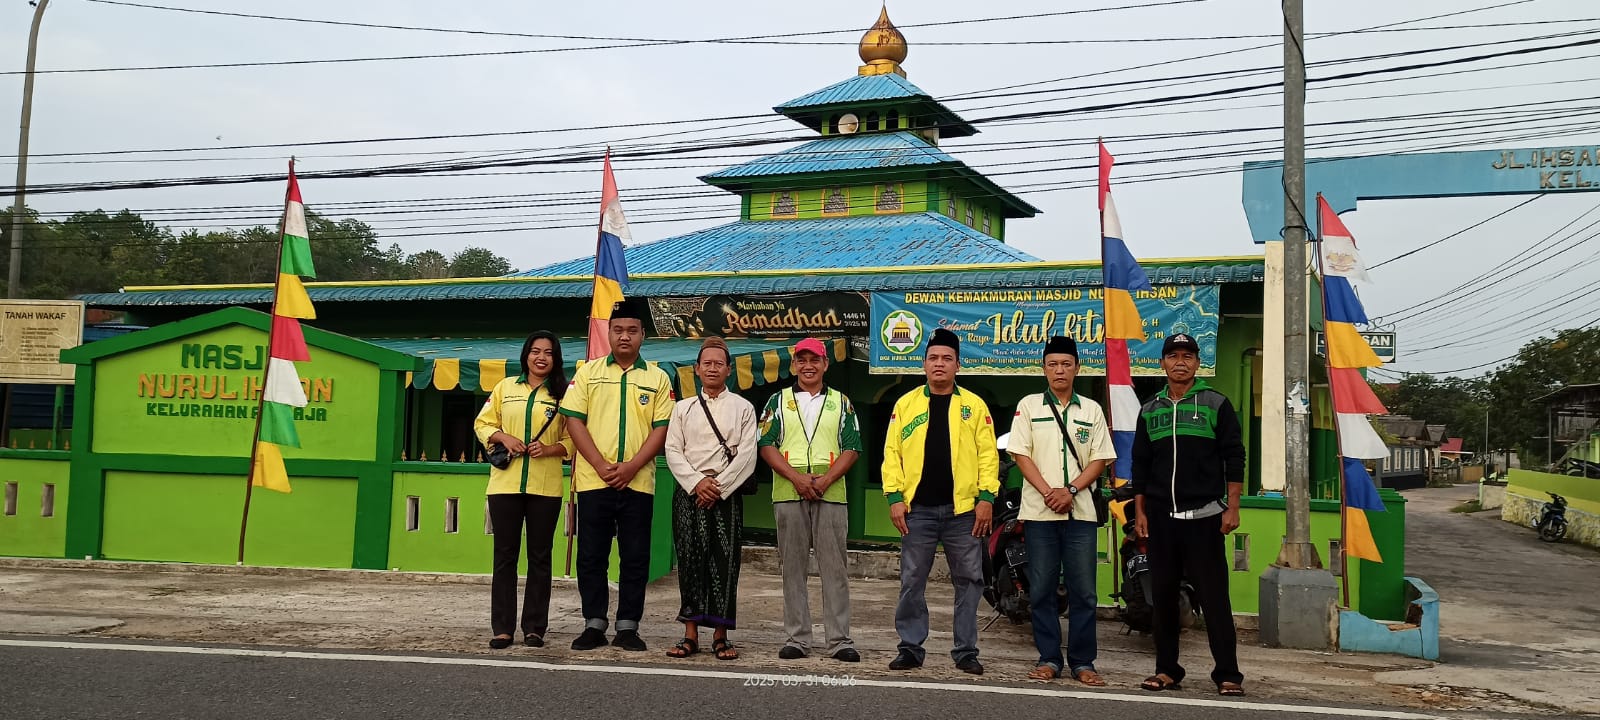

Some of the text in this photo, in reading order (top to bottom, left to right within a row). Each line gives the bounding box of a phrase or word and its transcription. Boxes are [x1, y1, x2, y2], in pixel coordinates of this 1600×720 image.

[1540, 170, 1599, 188] KEL.
[905, 292, 945, 304] DEWAN
[948, 289, 1032, 303] KEMAKMURAN
[1035, 288, 1082, 301] MASJID
[5, 311, 67, 320] TANAH WAKAF
[722, 306, 842, 334] Ramadhan
[968, 333, 991, 346] Raya
[986, 309, 1057, 344] Idul
[138, 373, 334, 402] NURUL IHAN
[146, 402, 249, 419] KELURAHAN
